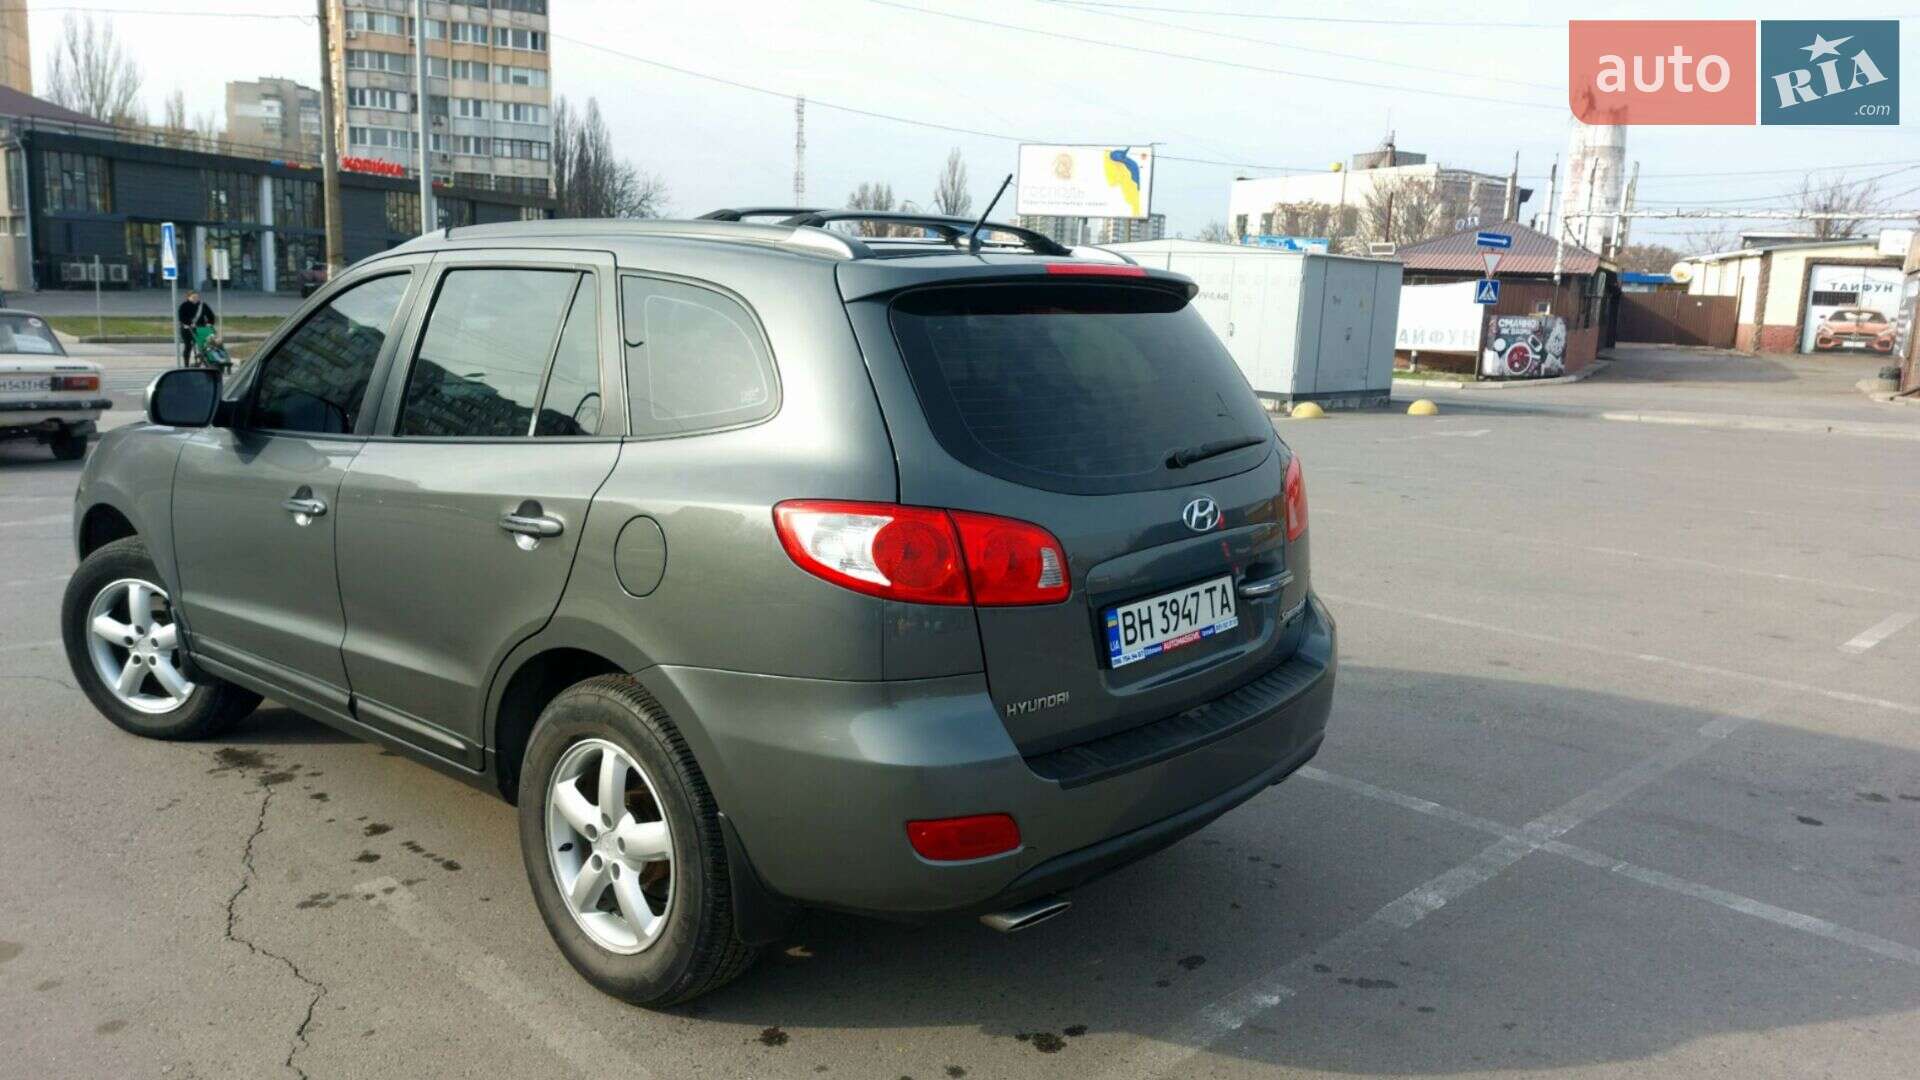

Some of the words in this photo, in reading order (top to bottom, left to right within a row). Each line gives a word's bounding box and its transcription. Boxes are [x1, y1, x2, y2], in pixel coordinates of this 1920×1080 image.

[1398, 325, 1476, 345] АЙФУН
[1121, 606, 1154, 646] BH
[1158, 591, 1200, 634] 3947
[1204, 583, 1232, 618] TA
[1006, 691, 1070, 718] HYUNDAI
